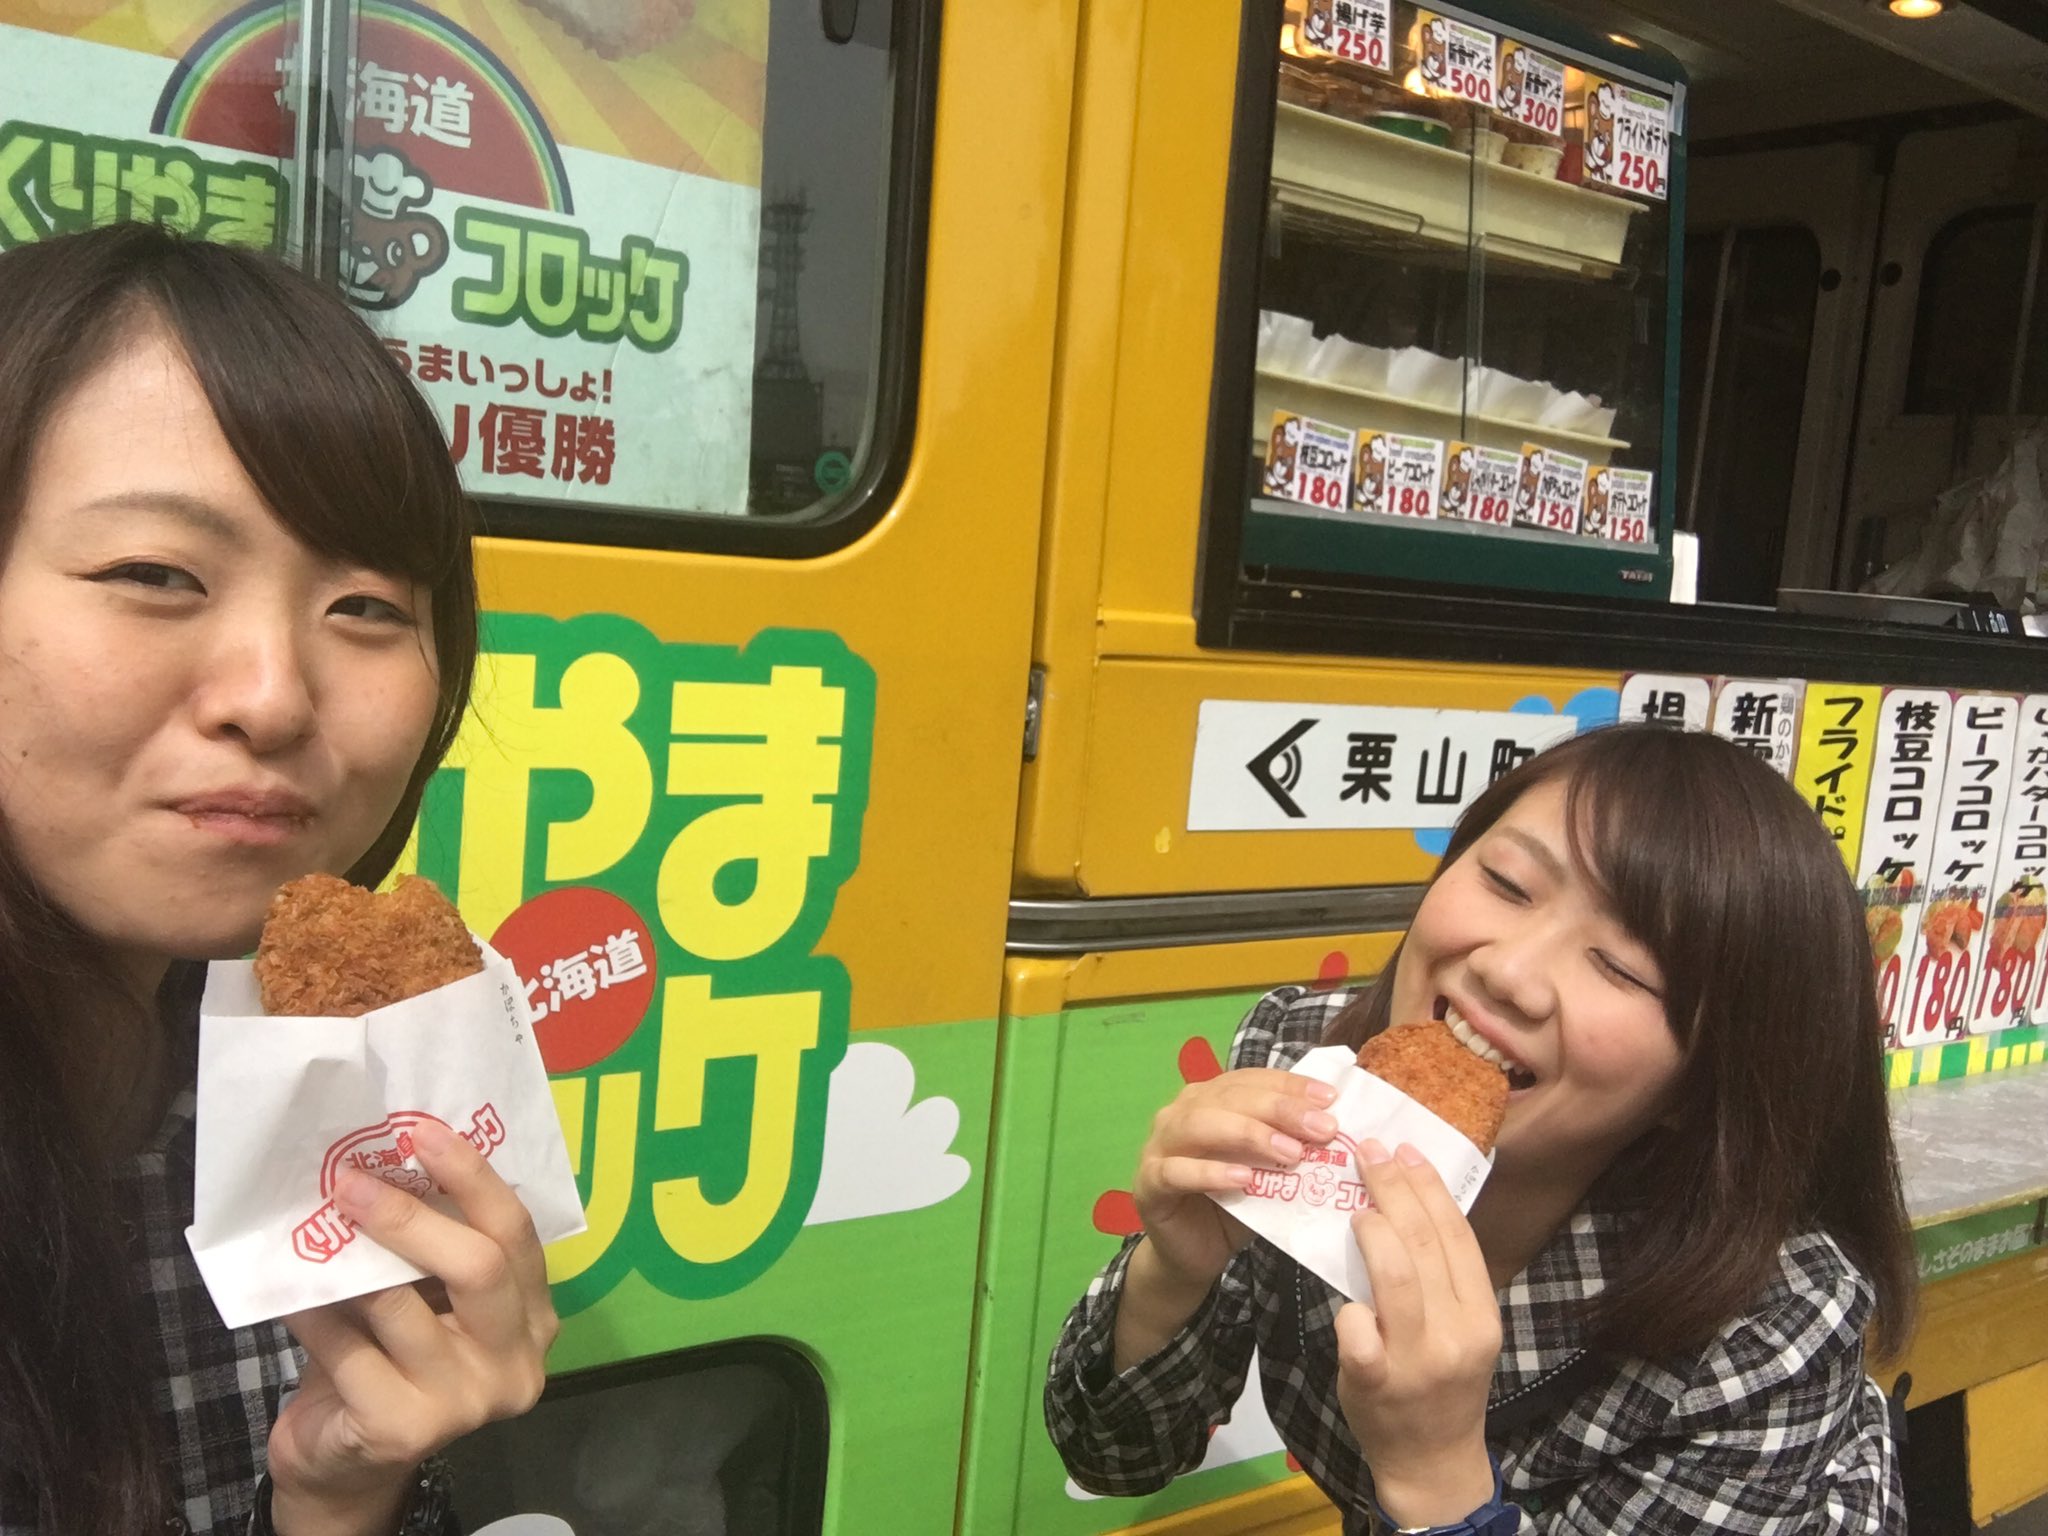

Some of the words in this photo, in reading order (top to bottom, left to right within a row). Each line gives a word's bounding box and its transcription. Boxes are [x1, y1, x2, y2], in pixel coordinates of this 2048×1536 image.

[1336, 28, 1384, 67] 250
[1451, 68, 1492, 103] 500
[1523, 98, 1558, 132] 300
[1299, 473, 1342, 508] 180
[1387, 486, 1430, 516] 180
[1468, 495, 1508, 522] 180
[1538, 499, 1573, 530] 150
[1610, 517, 1645, 543] 150
[1876, 701, 1940, 884] 枝豆コロッケ
[1944, 706, 2006, 882] ビーフコロッケ
